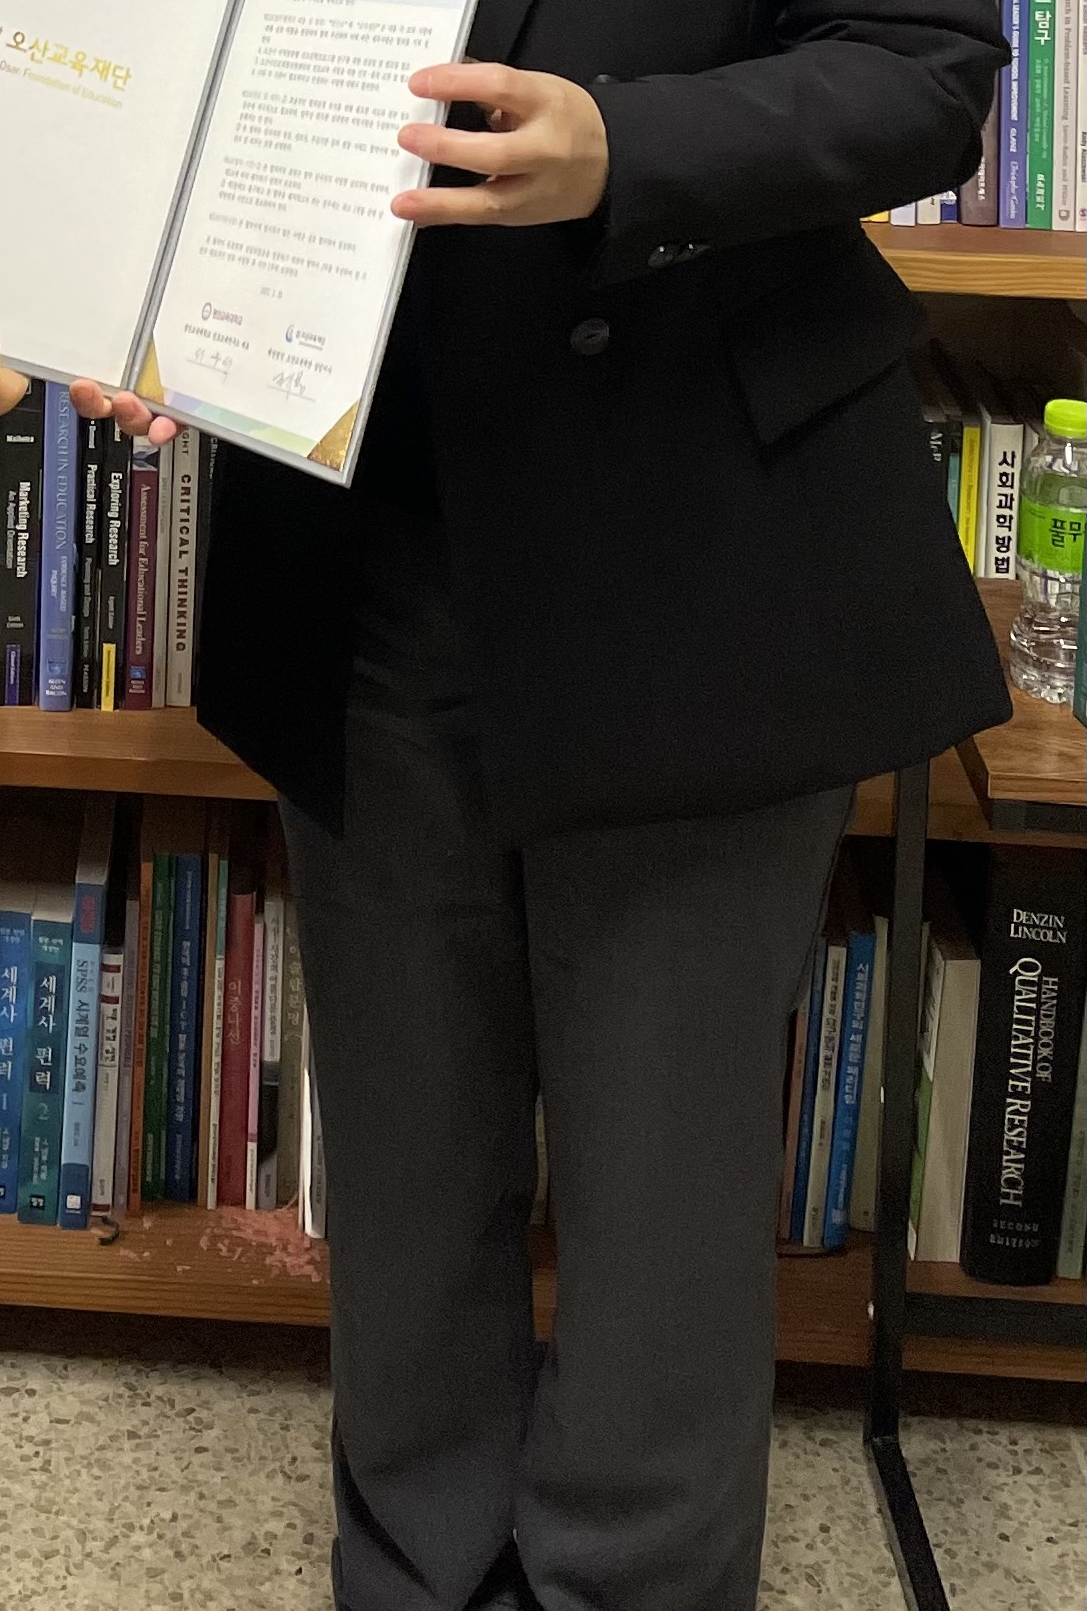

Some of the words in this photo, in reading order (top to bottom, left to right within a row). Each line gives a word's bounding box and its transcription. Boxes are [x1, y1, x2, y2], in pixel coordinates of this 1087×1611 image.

[1035, 10, 1051, 45] 탐구
[5, 30, 132, 91] 오산교육재단
[17, 481, 31, 532] Marketing
[178, 474, 191, 560] CRITICAL
[1049, 517, 1084, 548] 풀무
[16, 533, 30, 578] Research
[176, 567, 189, 652] THINKING
[1009, 924, 1067, 944] LINCOLN
[1012, 908, 1066, 928] DENZIN
[0, 966, 18, 1024] 세계사
[37, 975, 58, 1034] 세계사
[1036, 976, 1059, 1059] HANDBOOK
[1009, 957, 1042, 1094] QUALITATIVE
[35, 1047, 53, 1091] 편력
[1035, 1061, 1053, 1082] OF
[999, 1096, 1032, 1207] RESEARCH
